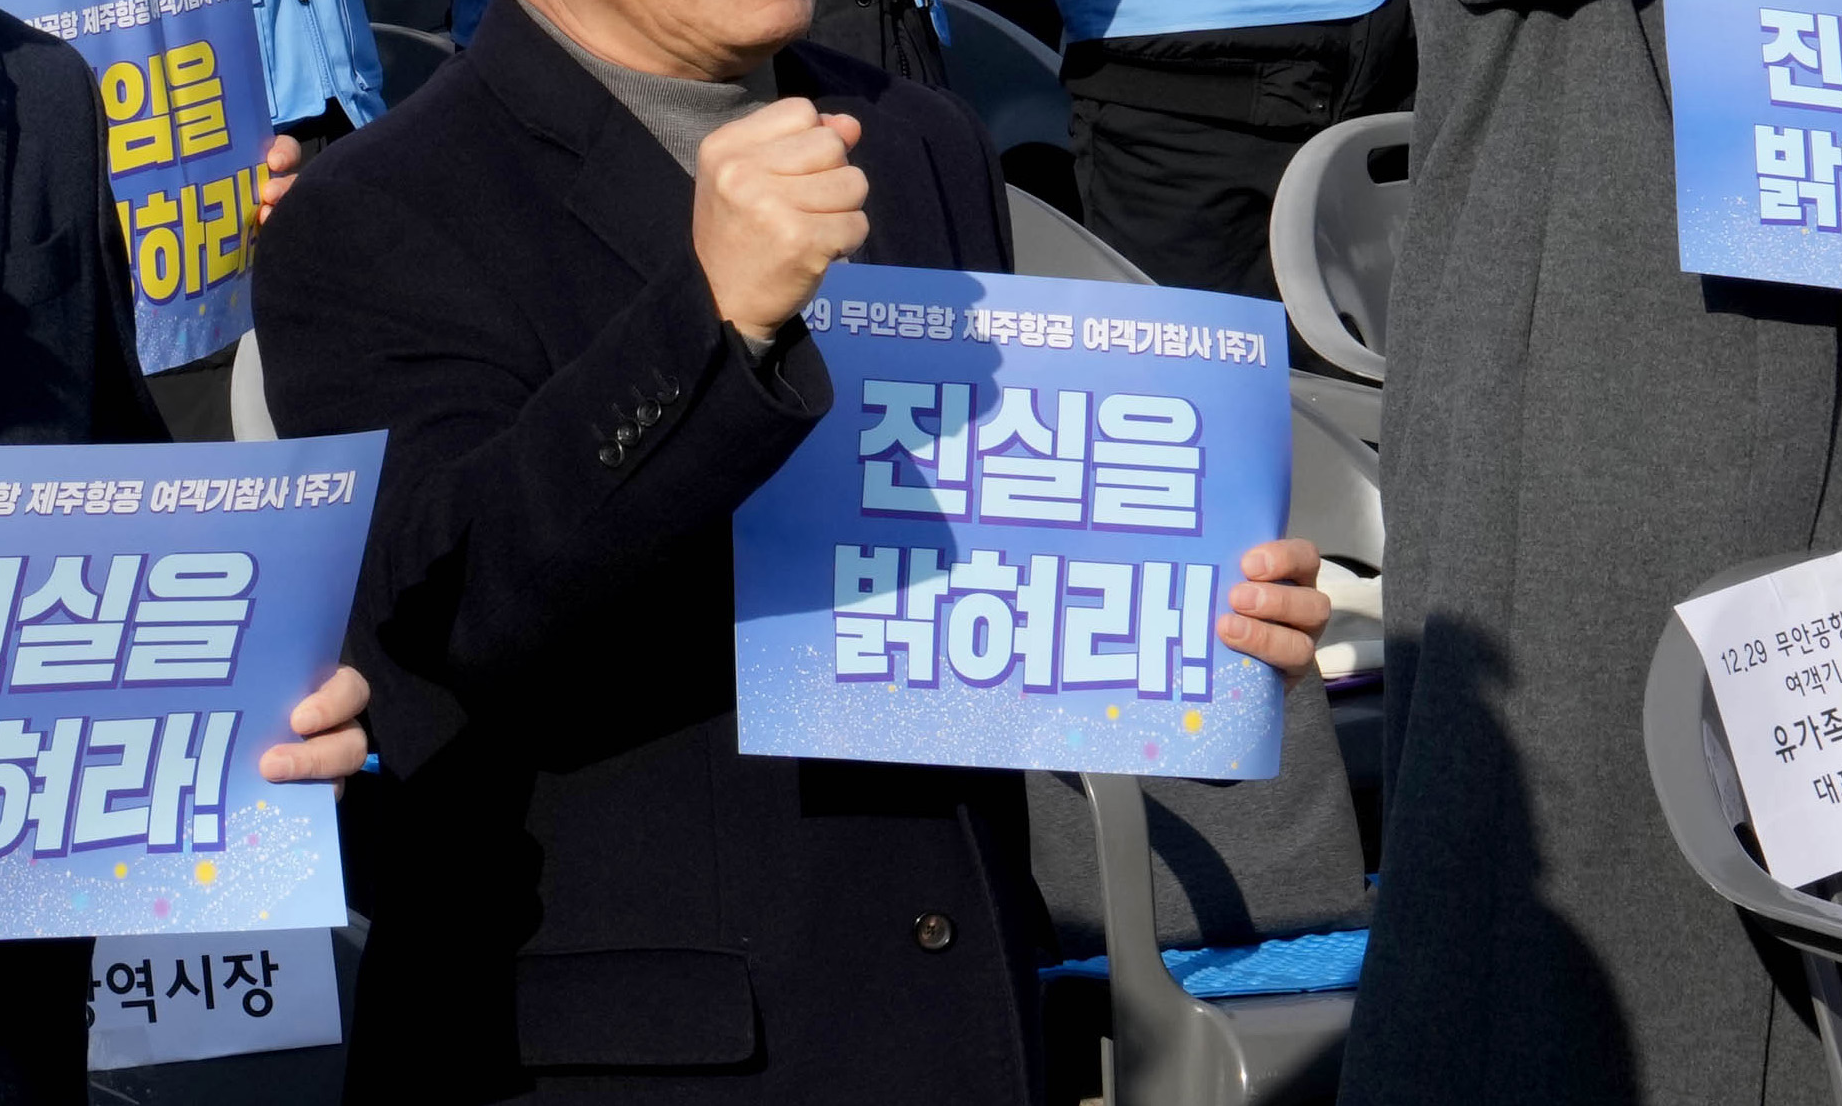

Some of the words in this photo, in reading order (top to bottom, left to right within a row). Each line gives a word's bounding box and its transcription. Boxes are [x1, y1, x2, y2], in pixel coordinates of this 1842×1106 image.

[23, 10, 79, 42] 공항
[98, 40, 231, 180] 임을
[840, 299, 956, 343] 무안공항
[963, 308, 1075, 351] 제주항공
[1083, 316, 1214, 362] 여객기참사
[1216, 329, 1268, 369] 1주기
[859, 378, 1206, 537] 진실을
[24, 479, 144, 516] 제주항공
[149, 475, 289, 515] 여객기참사
[294, 470, 357, 509] 1주기
[832, 543, 1220, 703] 밝혀라!
[1721, 638, 1769, 676] 12.29
